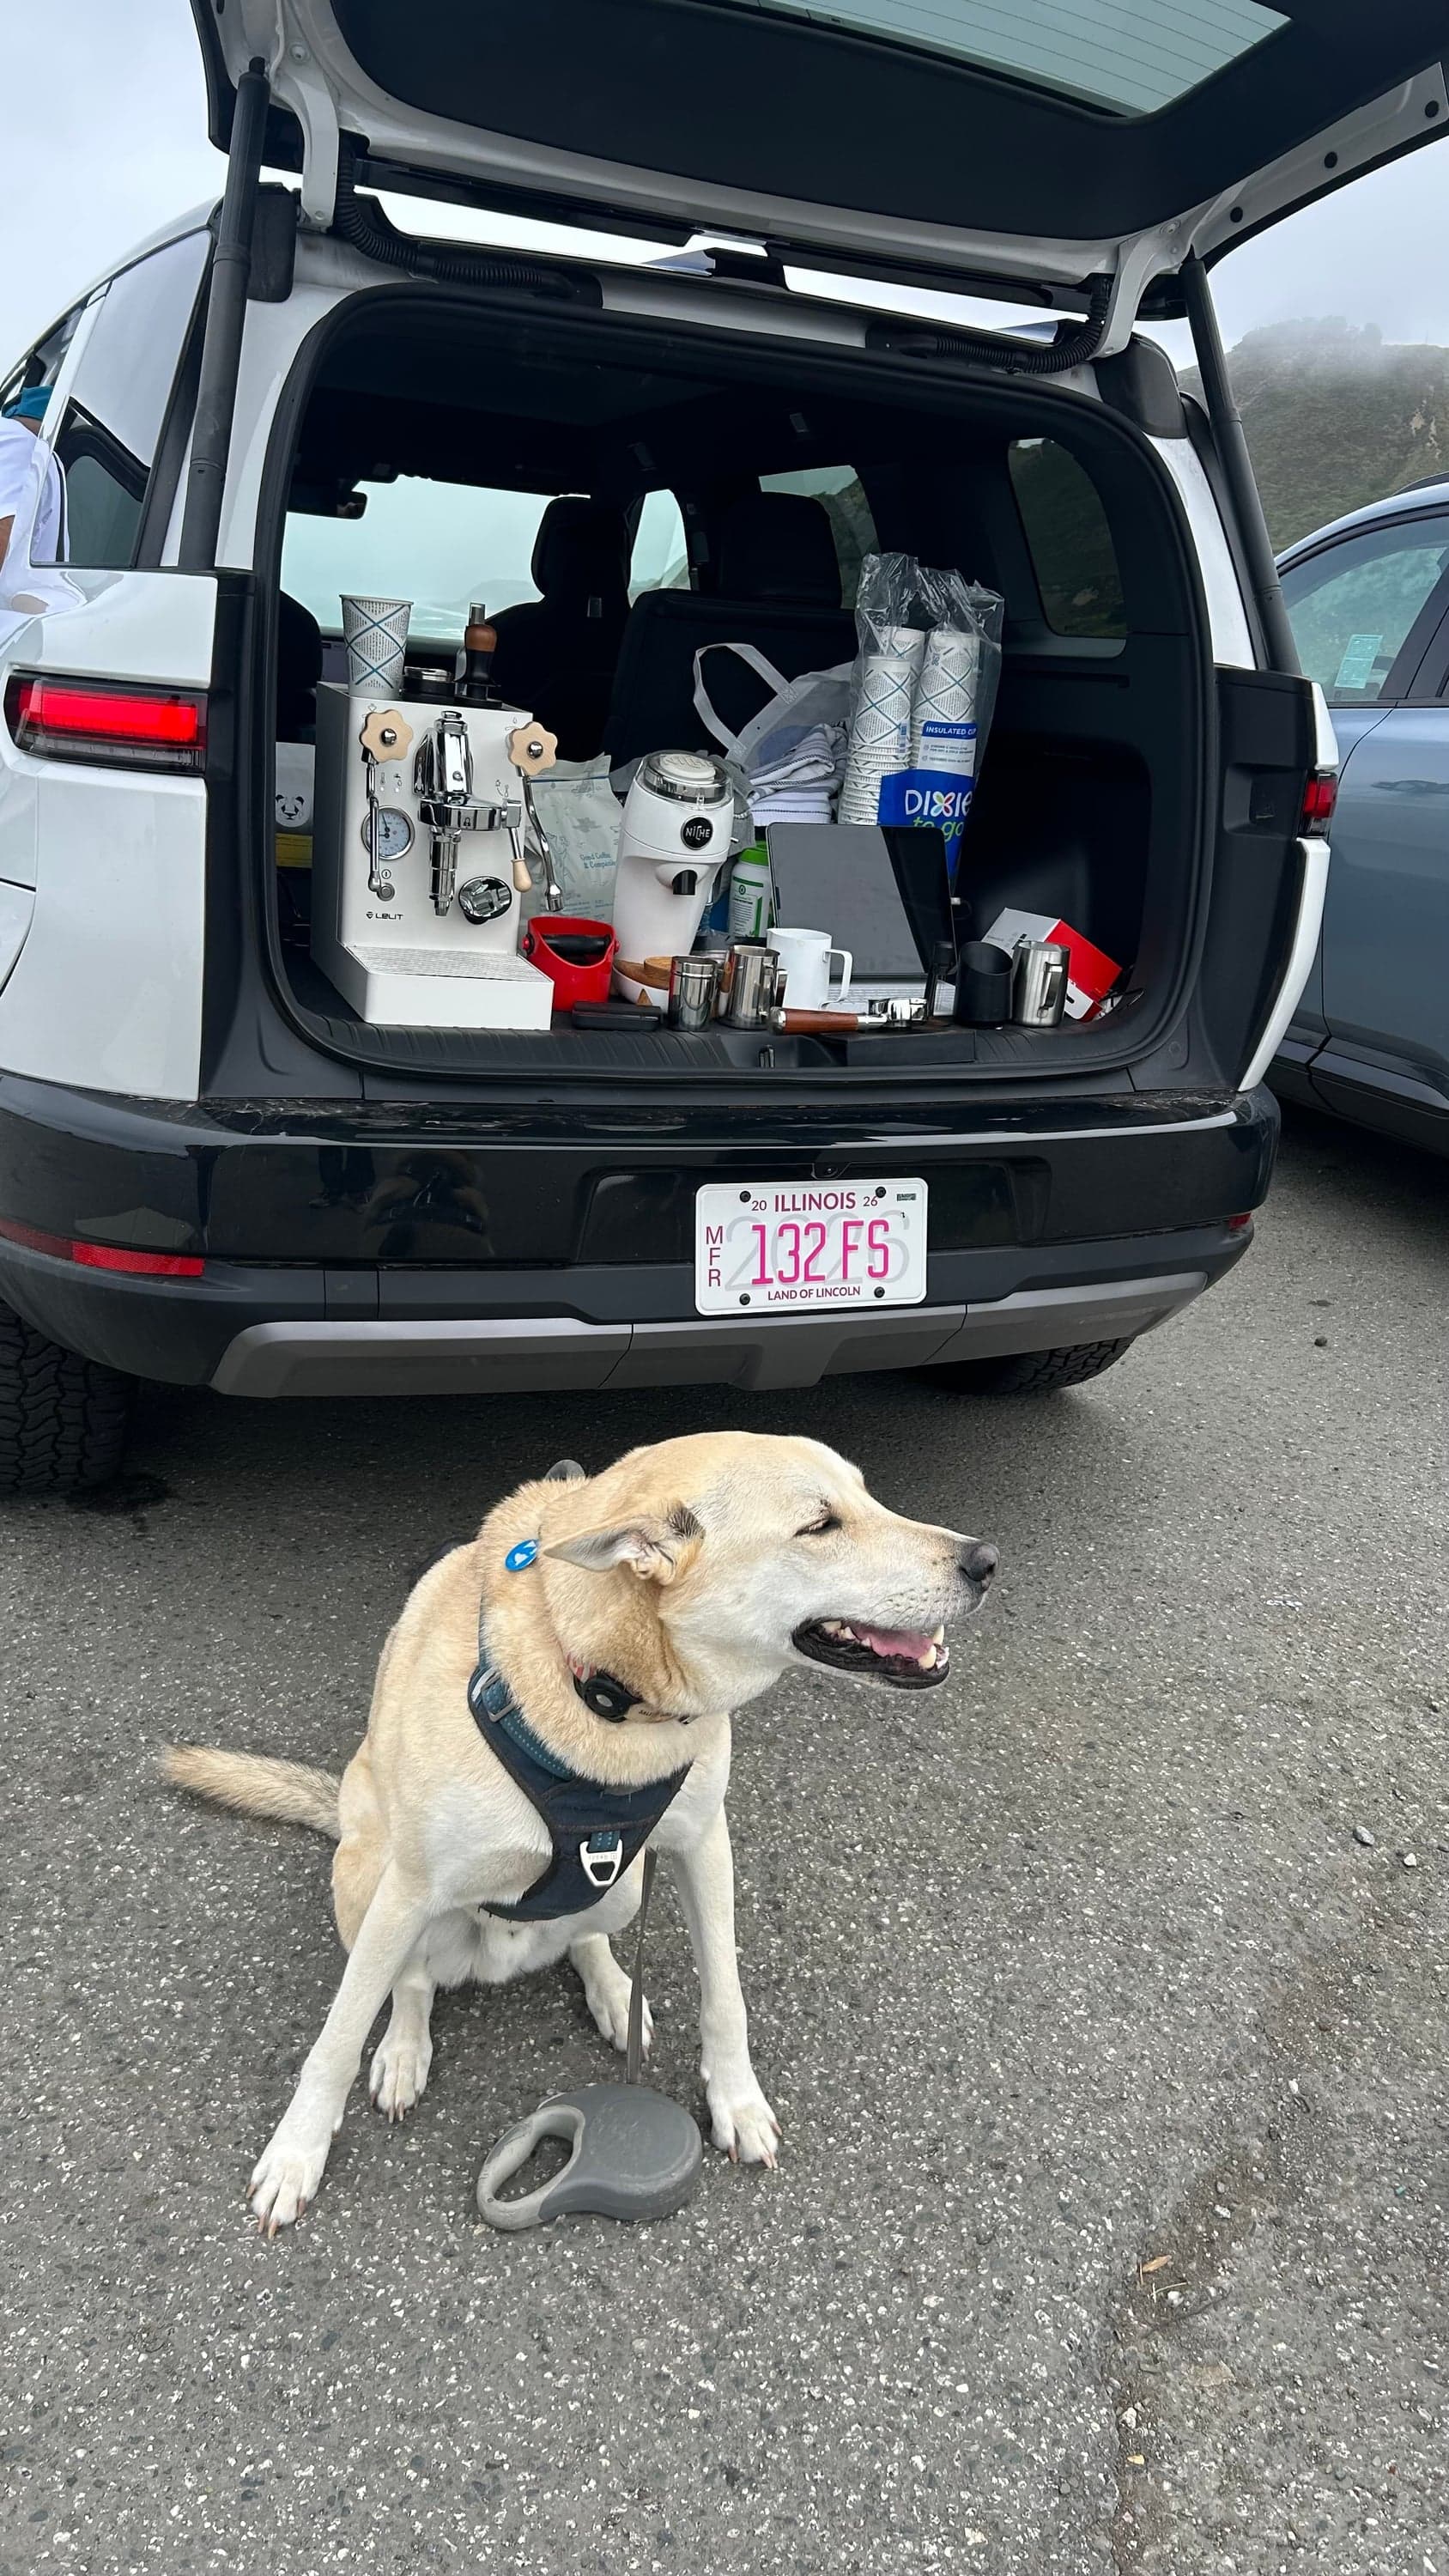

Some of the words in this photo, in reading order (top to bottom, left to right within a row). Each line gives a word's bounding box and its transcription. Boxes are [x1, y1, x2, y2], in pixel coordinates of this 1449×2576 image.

[925, 726, 967, 736] INSULATED
[685, 825, 711, 841] NICHE
[941, 820, 964, 842] go
[751, 1200, 767, 1212] 20
[774, 1192, 856, 1212] ILLINOIS
[863, 1196, 878, 1207] 26
[751, 1221, 826, 1285] 132
[842, 1219, 889, 1280] FS
[767, 1289, 797, 1301] LAND
[799, 1288, 814, 1299] OF
[816, 1285, 861, 1298] LINCOLN
